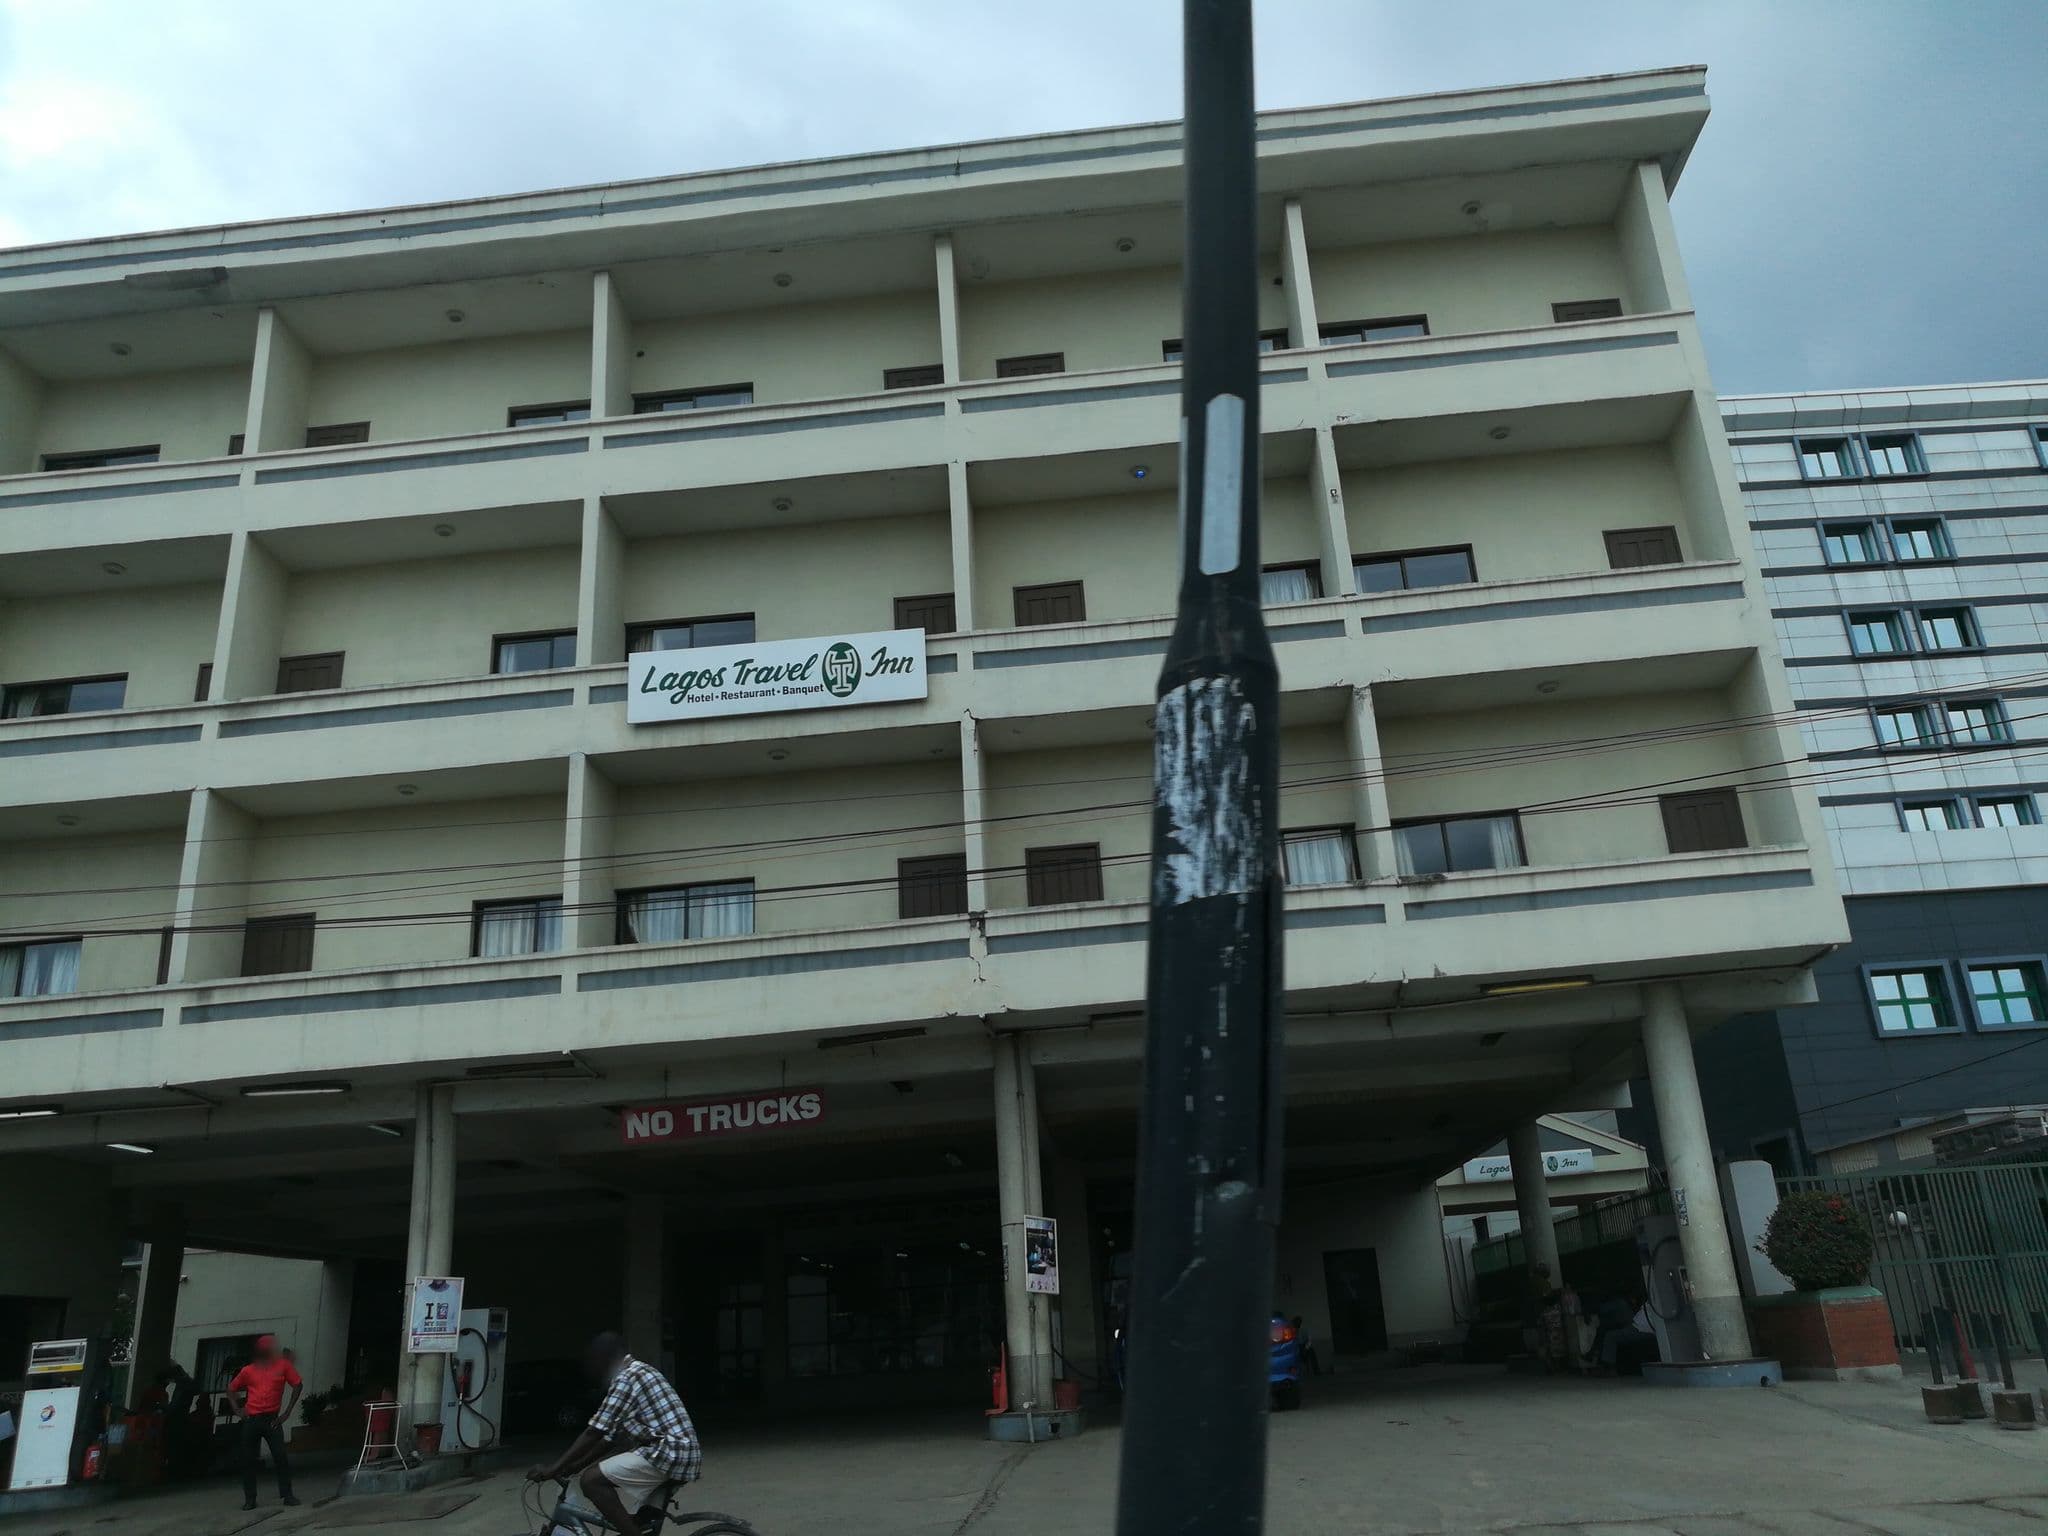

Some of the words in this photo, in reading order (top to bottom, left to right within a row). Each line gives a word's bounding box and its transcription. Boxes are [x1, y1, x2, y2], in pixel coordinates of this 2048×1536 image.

[641, 665, 726, 704] Lagos
[733, 653, 819, 686] Travel
[865, 646, 914, 677] Inn
[687, 692, 715, 704] Hotel
[721, 687, 776, 701] Restaurant
[783, 683, 825, 697] Banquet
[626, 1110, 675, 1139] NO
[686, 1093, 822, 1133] TRUCKS
[1479, 1164, 1510, 1177] Lagos
